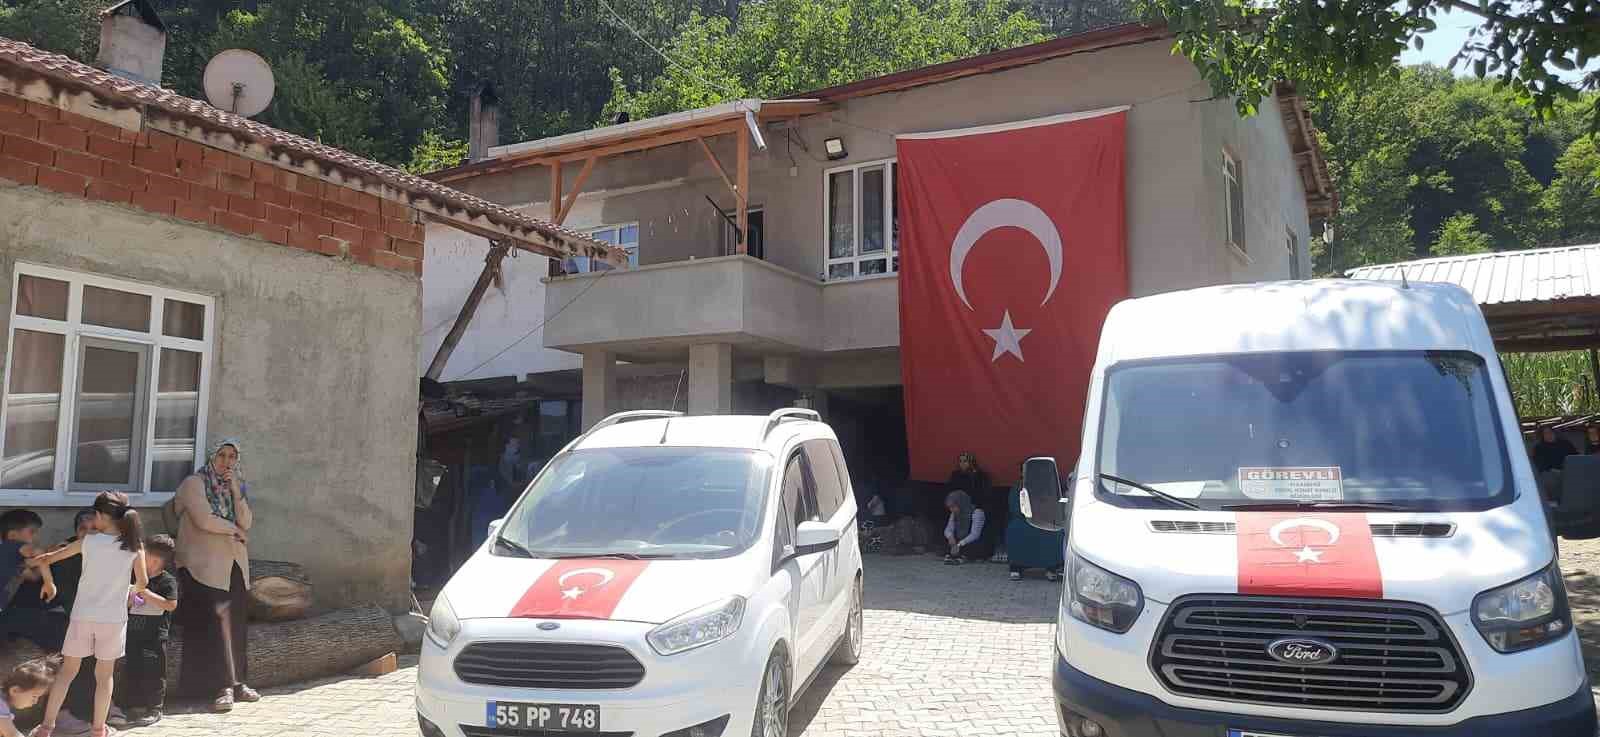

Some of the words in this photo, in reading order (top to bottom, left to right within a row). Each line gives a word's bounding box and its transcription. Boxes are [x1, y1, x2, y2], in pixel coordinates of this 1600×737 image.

[1284, 643, 1321, 660] Ford
[496, 705, 520, 726] 55
[526, 706, 551, 727] PP
[559, 707, 596, 729] 748
